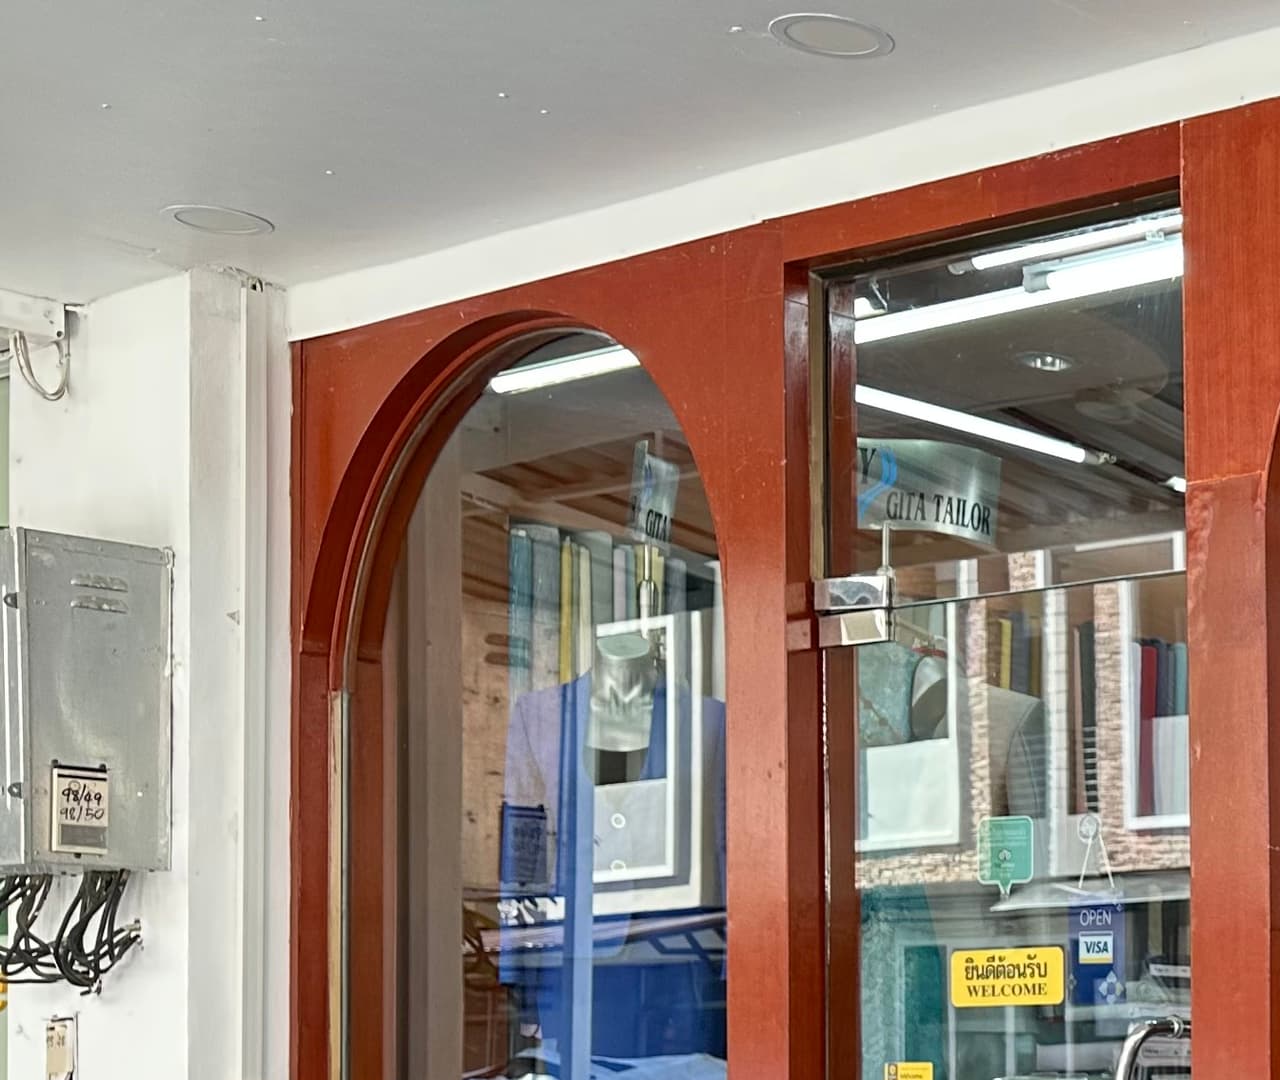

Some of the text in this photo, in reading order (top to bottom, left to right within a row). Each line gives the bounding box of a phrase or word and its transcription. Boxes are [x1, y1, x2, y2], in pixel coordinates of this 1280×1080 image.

[886, 491, 991, 535] GITA TAILOR
[1079, 910, 1112, 926] OPEN
[1084, 941, 1109, 954] VISA
[964, 954, 1048, 981] ยินดีต้อนรับ
[967, 983, 1048, 998] WELCOME
